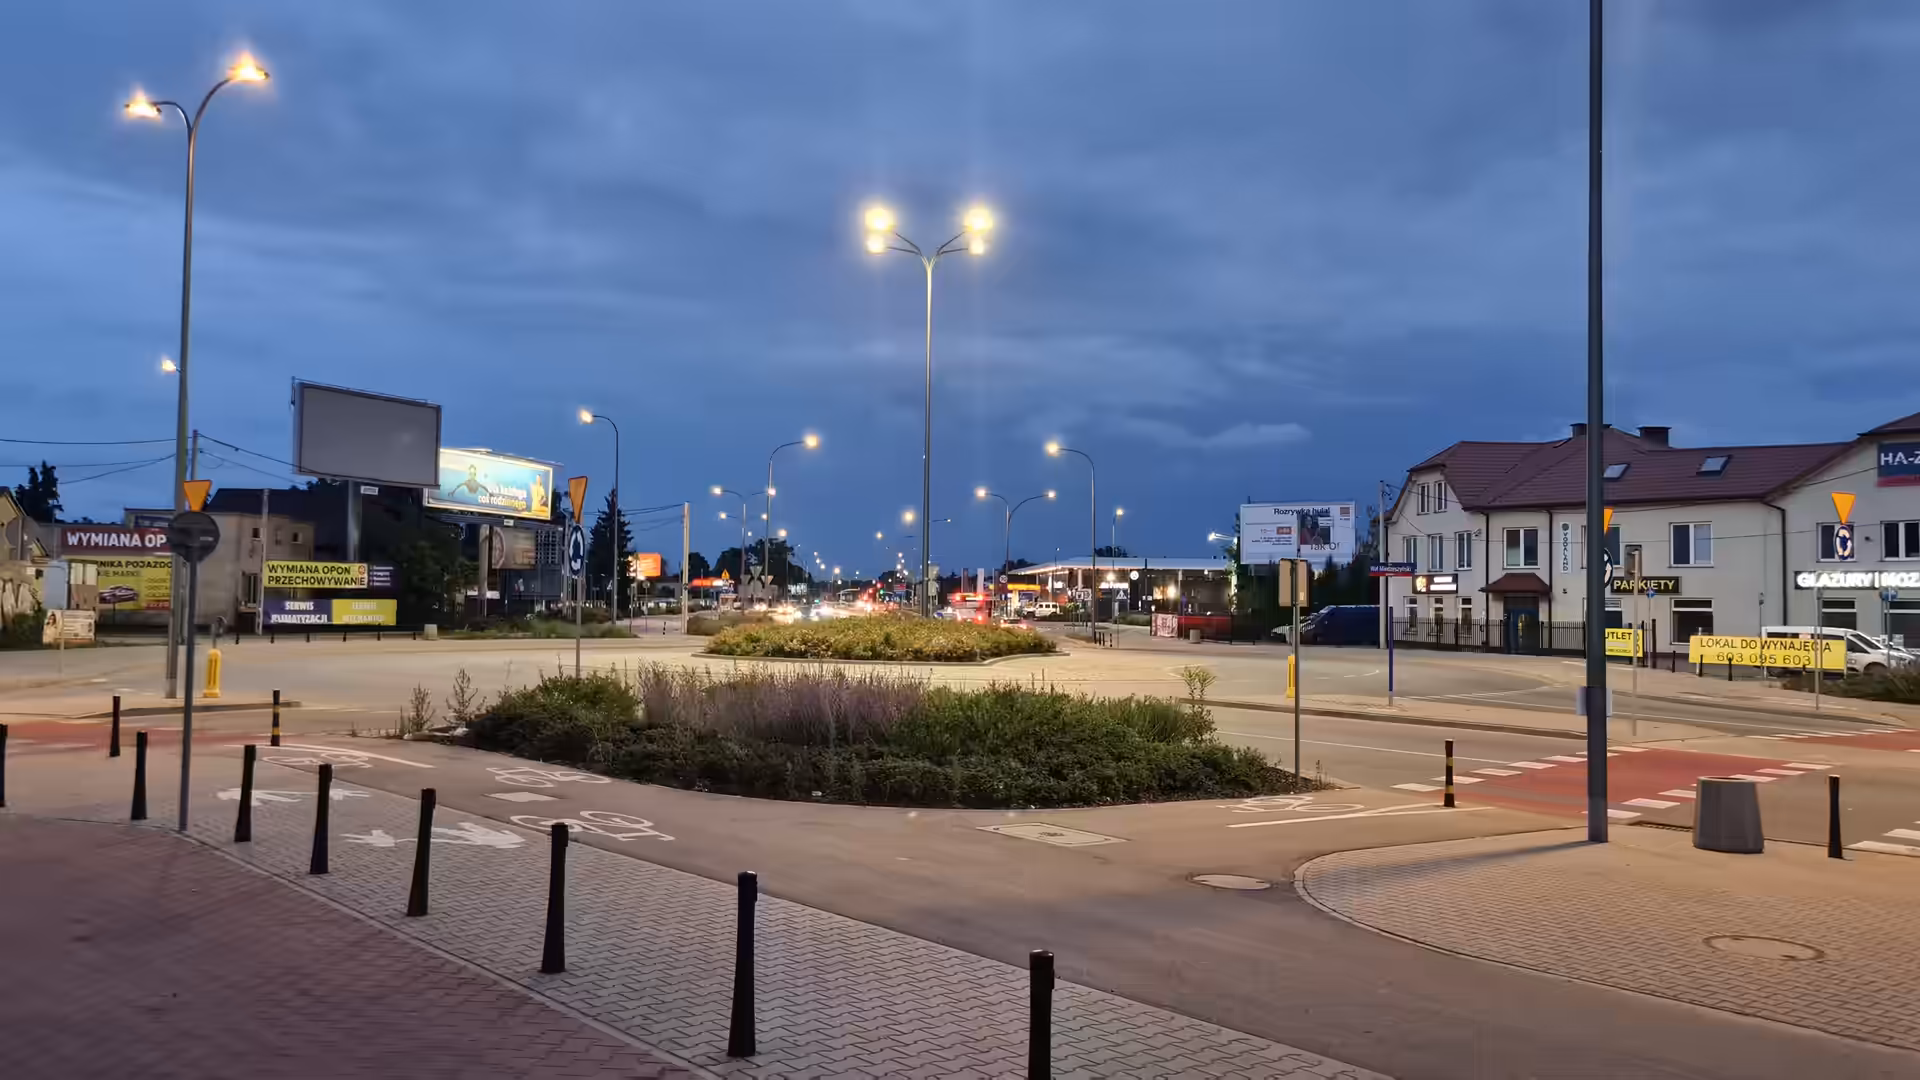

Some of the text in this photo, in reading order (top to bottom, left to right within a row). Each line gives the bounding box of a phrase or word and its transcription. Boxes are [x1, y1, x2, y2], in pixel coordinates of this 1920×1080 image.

[1273, 507, 1310, 516] Rozrywka
[67, 532, 142, 548] WYMIANA
[267, 564, 351, 575] WYMIANA OPON
[267, 575, 366, 586] PRZECHOWYWANIE
[1613, 579, 1675, 590] PARKIETY
[1700, 638, 1832, 653] LOKAL DO WYNAJĘCA
[1716, 651, 1811, 666] 603 095 603
